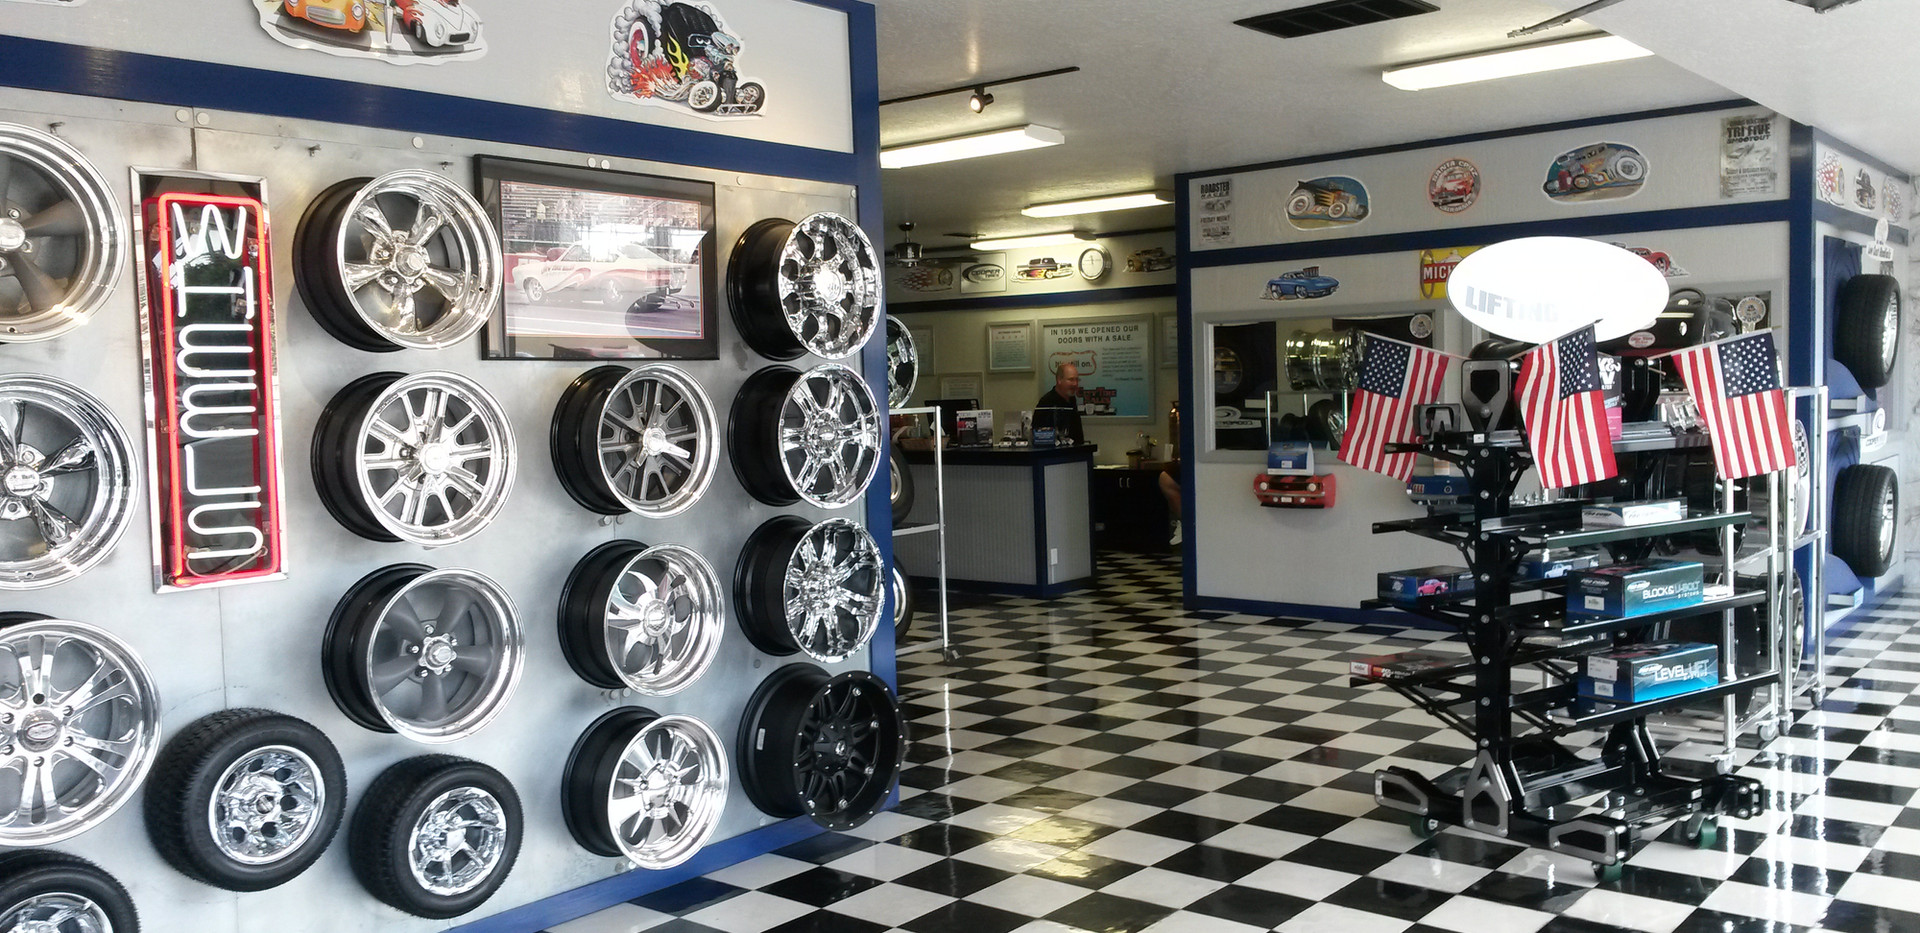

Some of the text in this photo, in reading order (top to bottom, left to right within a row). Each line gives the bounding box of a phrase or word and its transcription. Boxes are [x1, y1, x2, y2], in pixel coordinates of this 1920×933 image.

[1727, 124, 1771, 138] TRI FIVE
[1726, 134, 1771, 144] SHOOTOUT
[1431, 160, 1478, 182] SANTA CRUZ
[1200, 181, 1230, 194] ROADSTER
[971, 268, 1001, 276] COOPER
[1465, 285, 1559, 322] LIFTING
[1060, 328, 1076, 336] 1959
[1091, 325, 1121, 334] OPENED
[1123, 324, 1139, 332] OUR
[1085, 335, 1103, 343] WITH
[171, 201, 264, 561] WHEELS
[1675, 581, 1700, 592] U-BOLT
[1678, 591, 1700, 599] SYSTEMS
[1655, 659, 1710, 682] LEVEL LIFT
